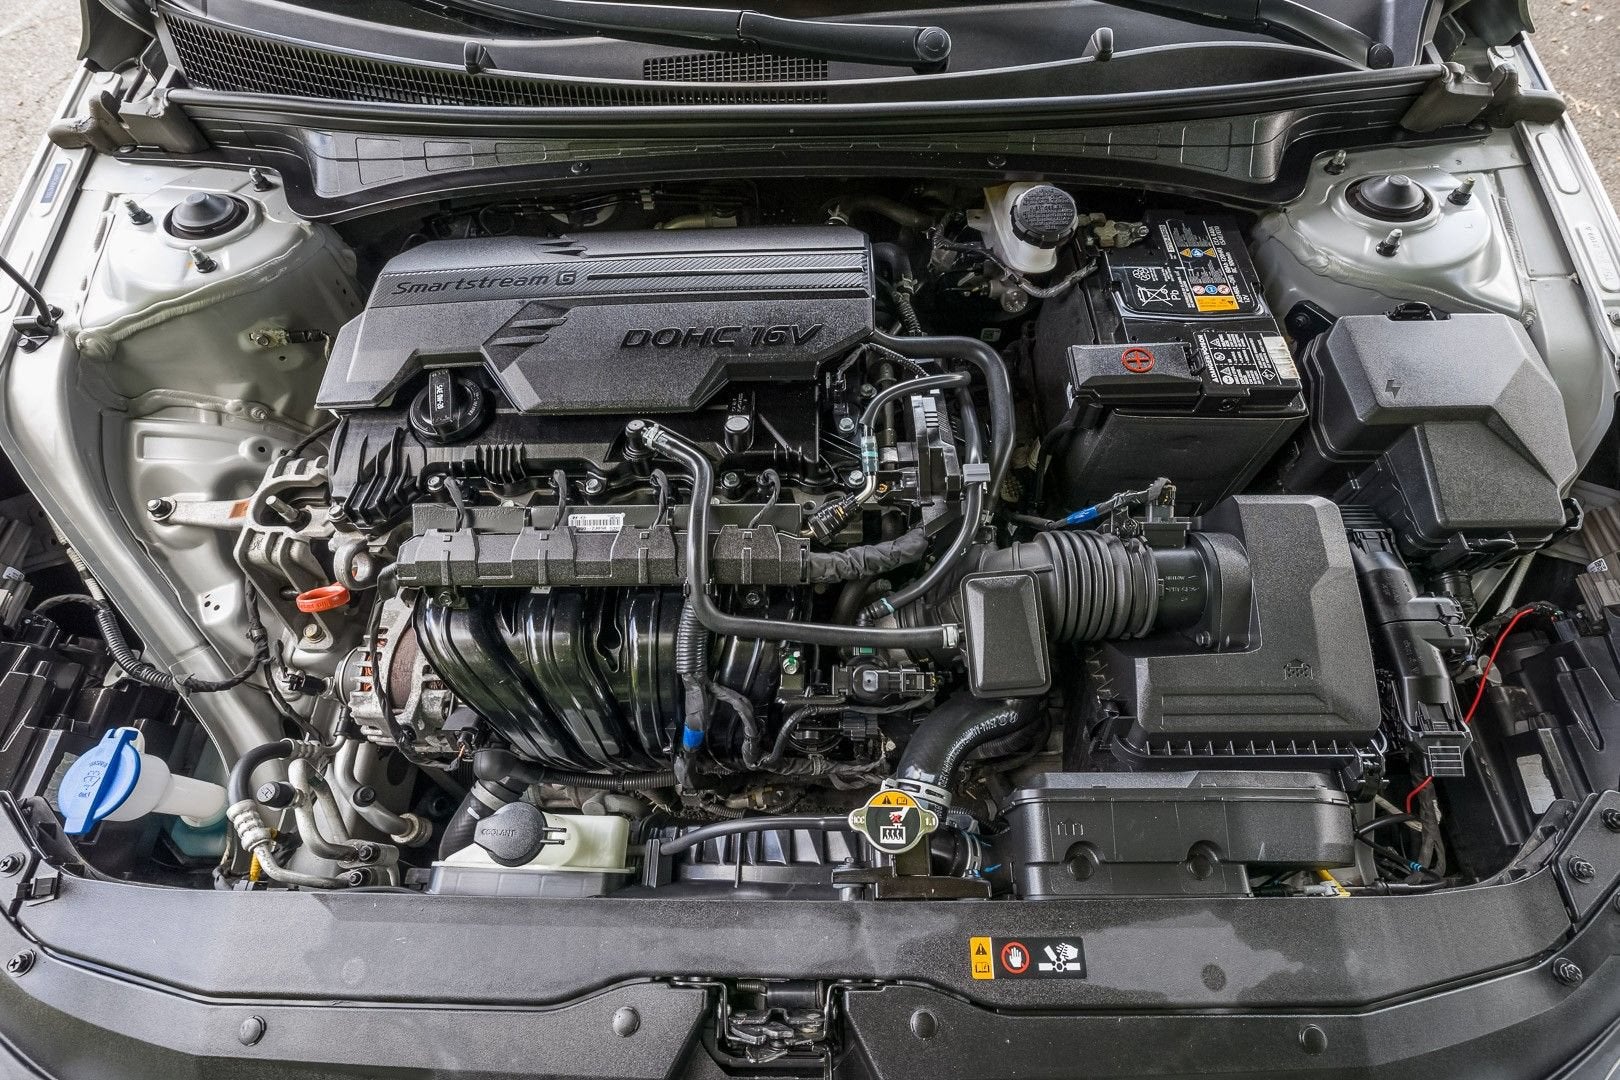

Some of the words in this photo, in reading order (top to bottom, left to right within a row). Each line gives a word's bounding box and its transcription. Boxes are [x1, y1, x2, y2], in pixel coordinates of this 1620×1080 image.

[391, 274, 550, 295] Smartstream
[1170, 289, 1181, 301] Pb
[621, 325, 742, 348] DOHC
[751, 323, 824, 348] 16V
[925, 816, 936, 826] 1.1
[481, 828, 516, 837] COOLANT
